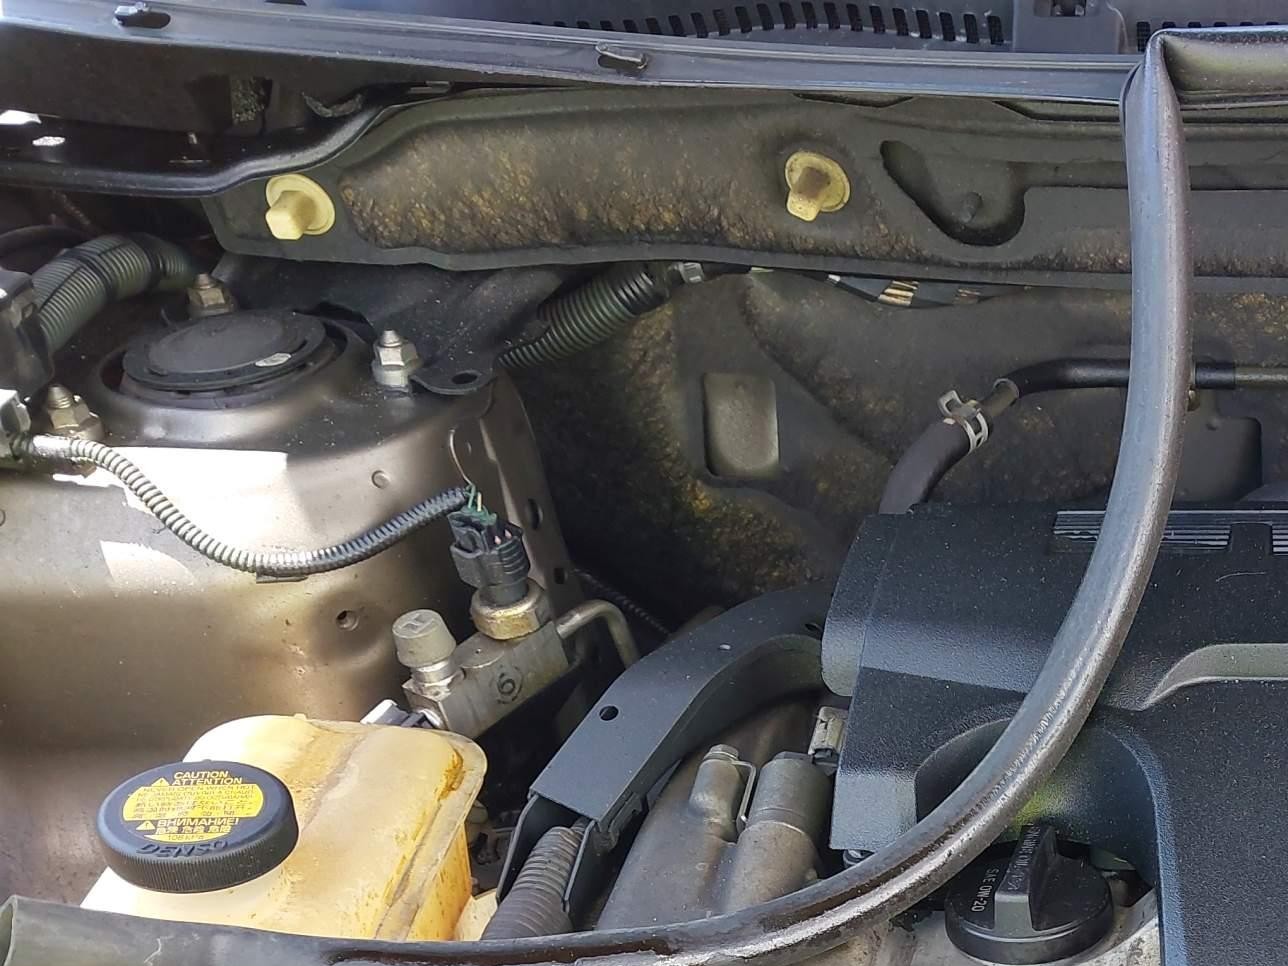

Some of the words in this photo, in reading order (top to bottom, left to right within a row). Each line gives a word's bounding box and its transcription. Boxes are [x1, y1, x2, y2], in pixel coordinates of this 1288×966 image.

[172, 777, 242, 786] ATTENTION
[174, 771, 229, 779] CAUTION
[158, 817, 240, 827] ВНИМАНИЕ!
[136, 840, 229, 858] DENSO
[983, 867, 1000, 884] SAE
[971, 885, 993, 912] 0W-20
